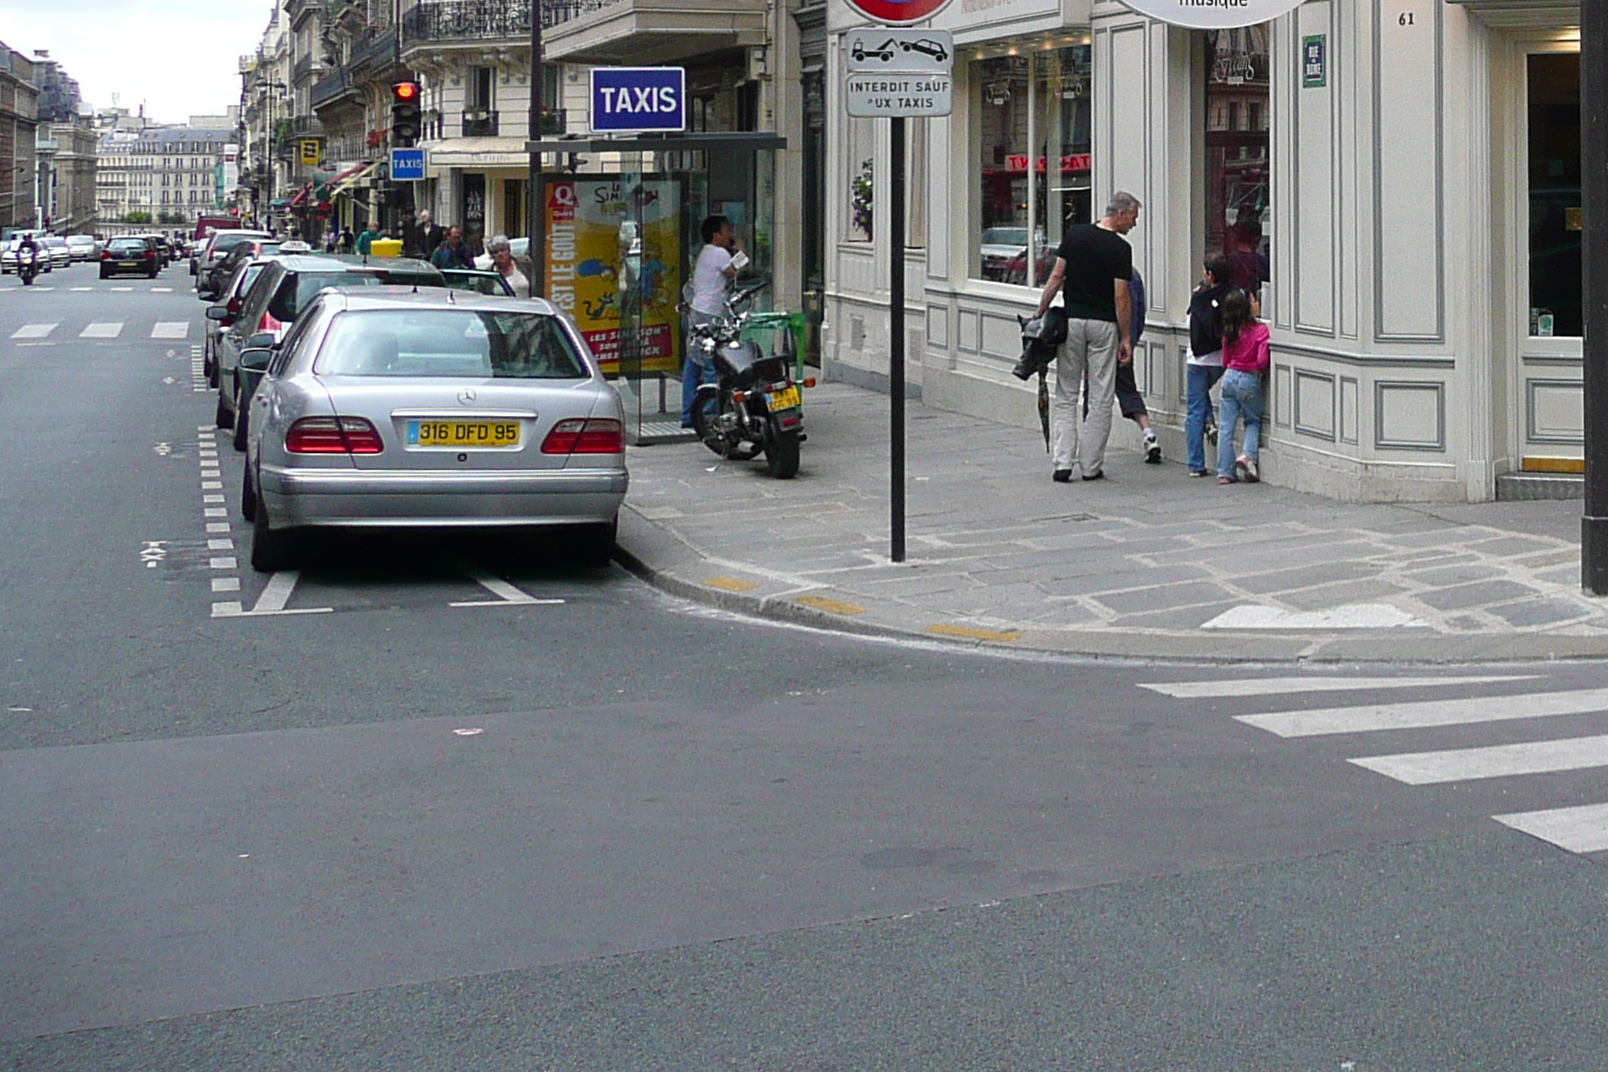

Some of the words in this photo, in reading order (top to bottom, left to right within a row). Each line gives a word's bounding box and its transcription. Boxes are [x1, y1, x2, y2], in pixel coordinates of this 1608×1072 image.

[1398, 12, 1415, 26] 61
[850, 81, 910, 93] INTERDIT
[915, 81, 950, 93] SAUF
[600, 86, 678, 114] TAXIS
[897, 97, 934, 109] TAXIS
[393, 158, 423, 170] TAXIS
[420, 424, 449, 440] 316
[455, 424, 489, 440] DFD
[494, 424, 517, 440] 95
